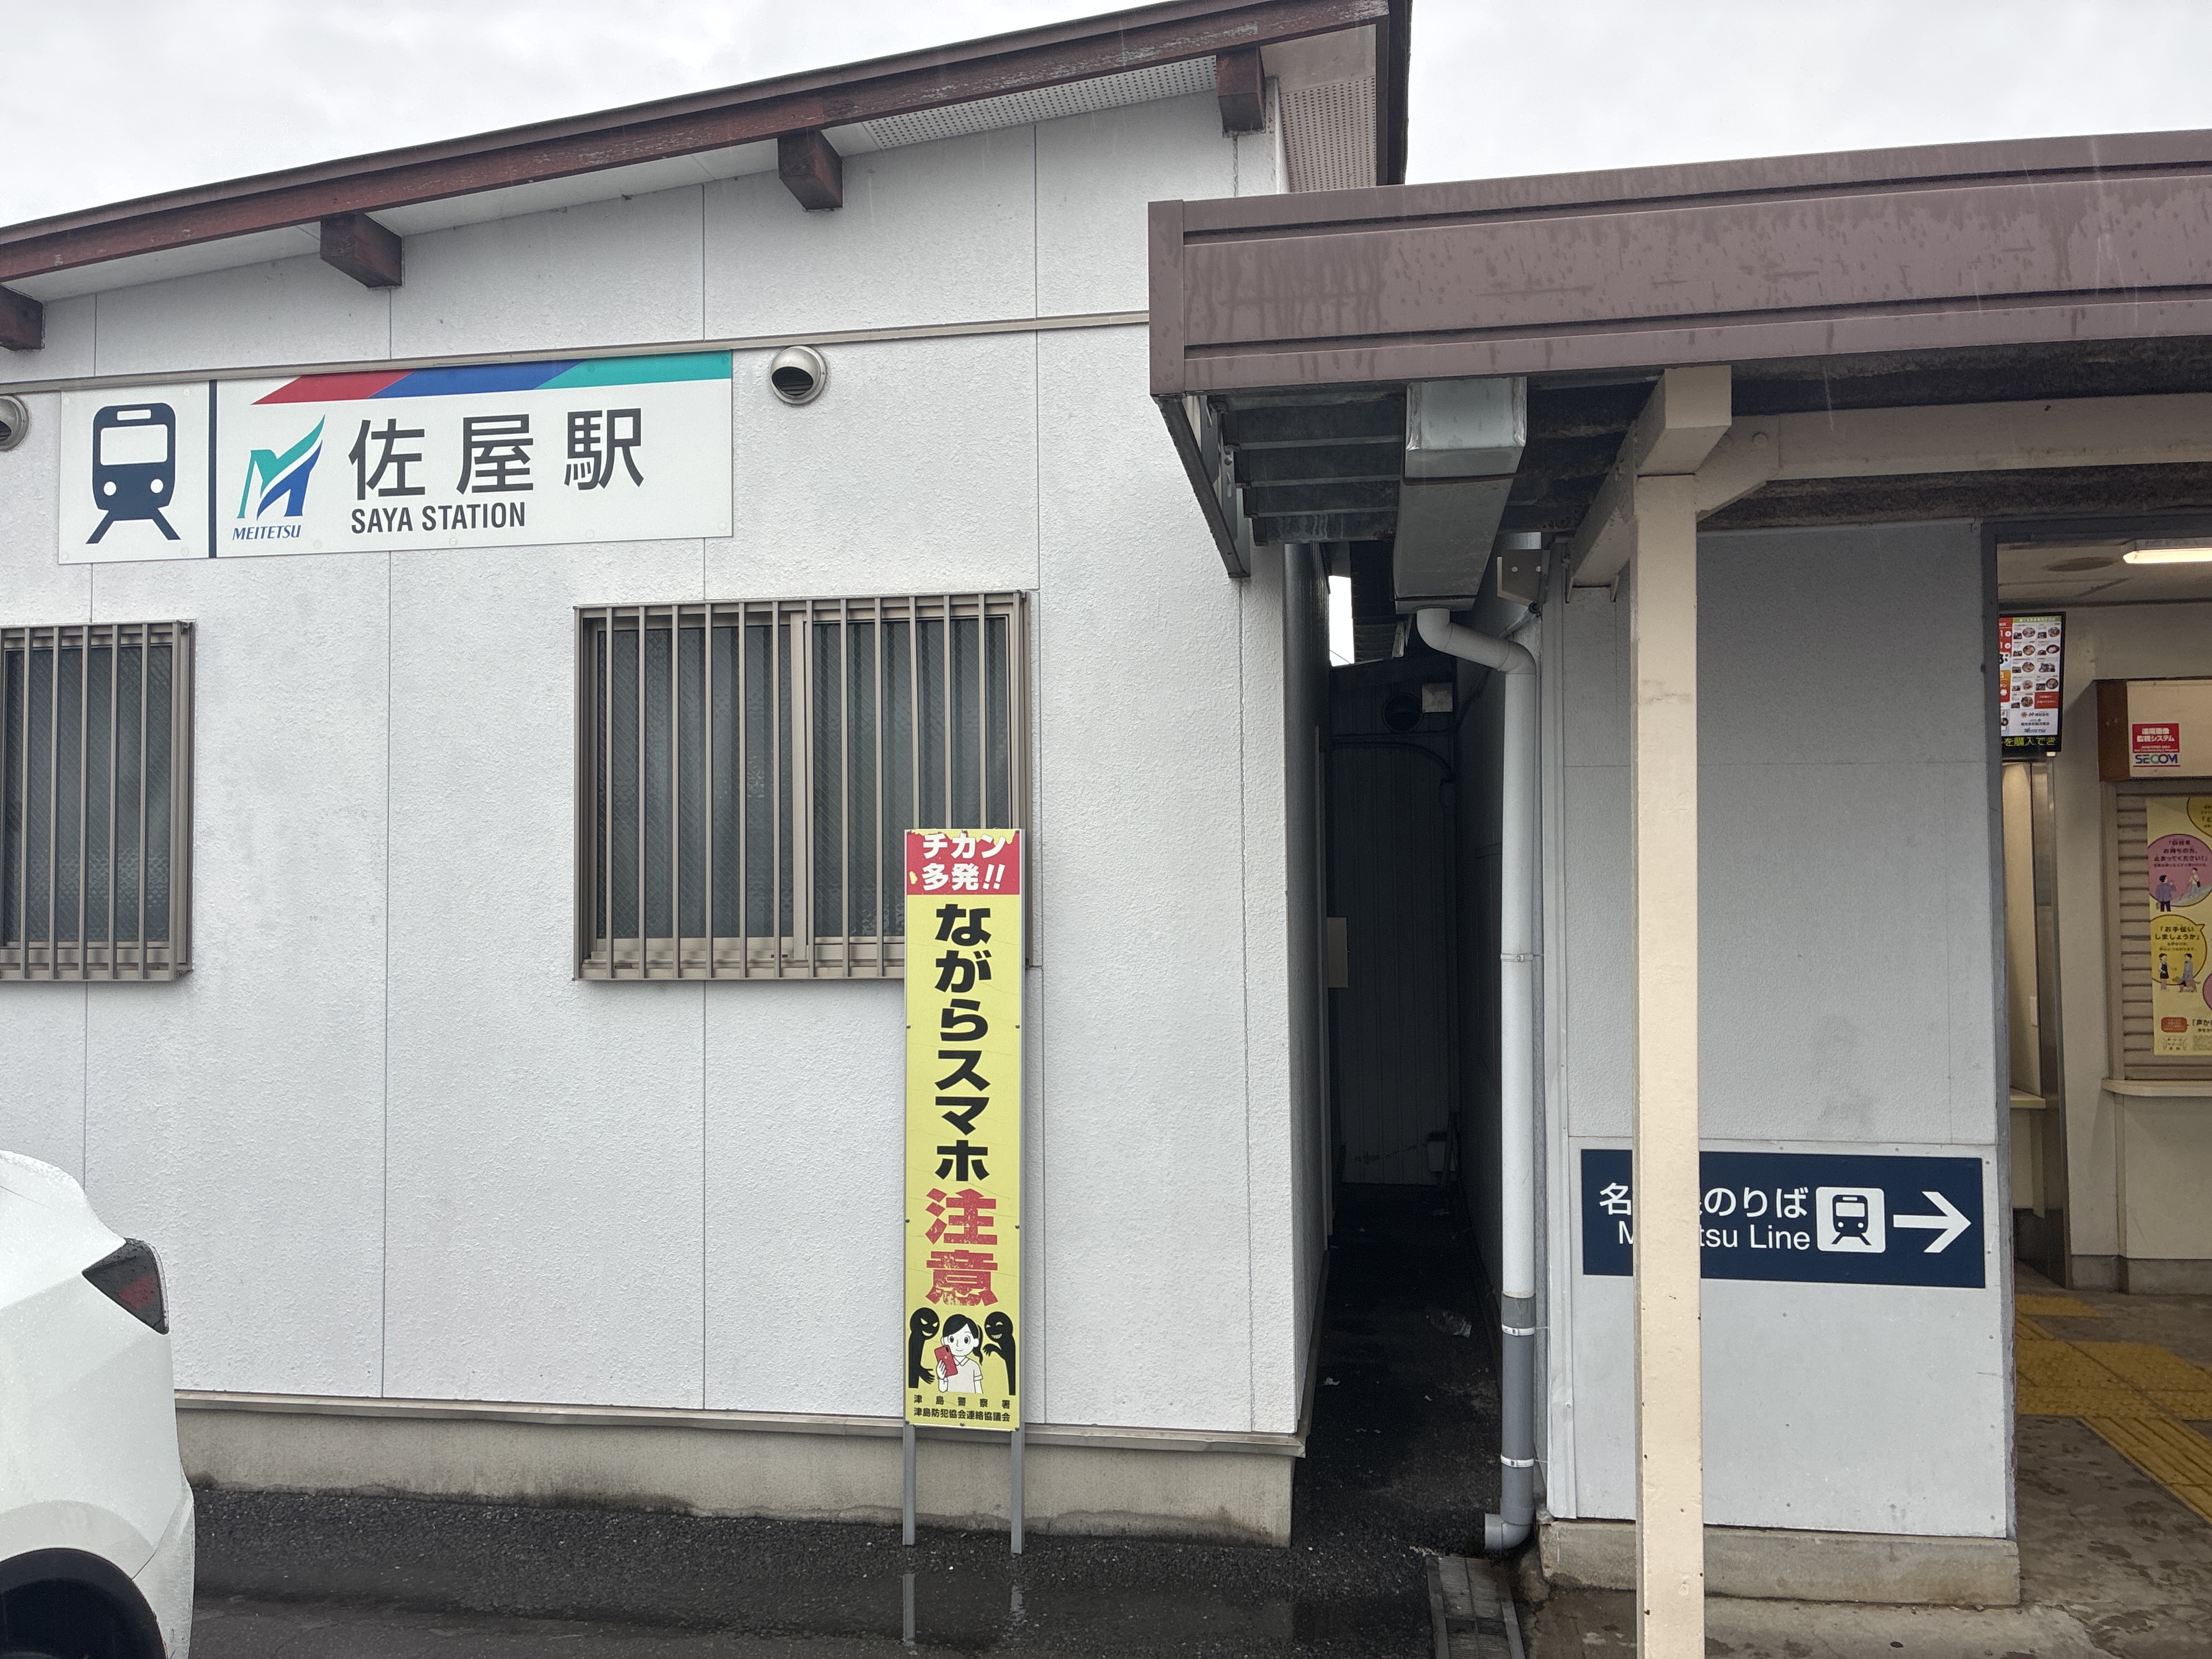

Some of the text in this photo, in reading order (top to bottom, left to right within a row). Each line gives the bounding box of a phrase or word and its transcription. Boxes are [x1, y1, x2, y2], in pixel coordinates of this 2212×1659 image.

[348, 407, 645, 501] 佐屋駅
[351, 501, 526, 534] SAYA STATION
[232, 524, 302, 541] MEITETSU
[2135, 753, 2178, 764] SECOM
[923, 833, 1006, 859] チカン
[1599, 1182, 1809, 1218] 名のりば
[1618, 1220, 1810, 1250] Mtsu Line
[913, 1394, 1011, 1409] 津島警察署
[913, 1407, 1011, 1422] 津島防犯協会連絡協議会
